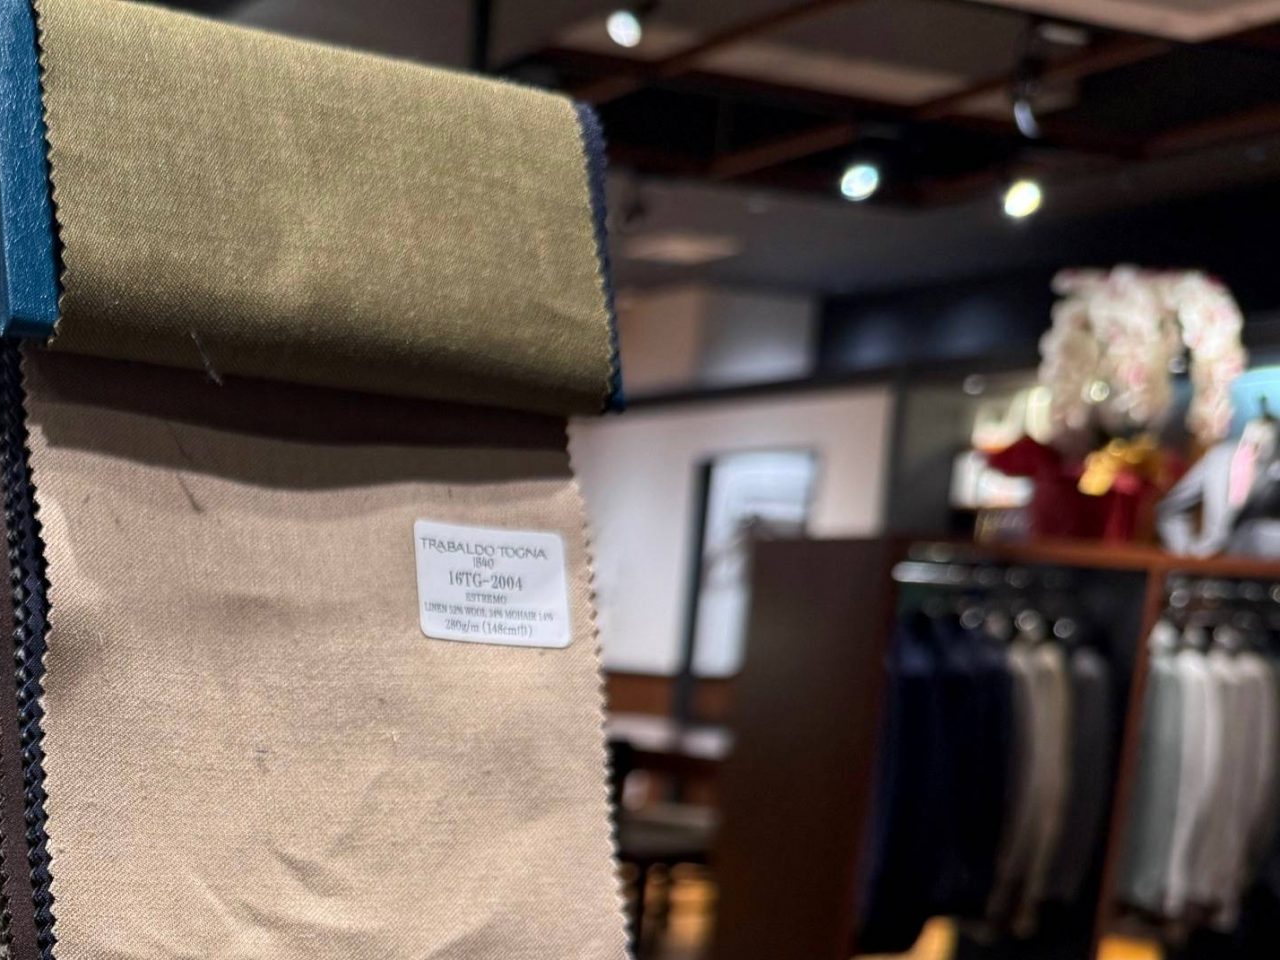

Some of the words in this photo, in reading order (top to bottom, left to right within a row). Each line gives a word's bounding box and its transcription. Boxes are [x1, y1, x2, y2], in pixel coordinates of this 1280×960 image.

[420, 537, 495, 557] TRABALDO
[498, 546, 548, 560] TOGNA
[473, 556, 494, 569] 1840
[449, 570, 523, 591] 16TG-2004
[445, 618, 479, 632] 280g/m
